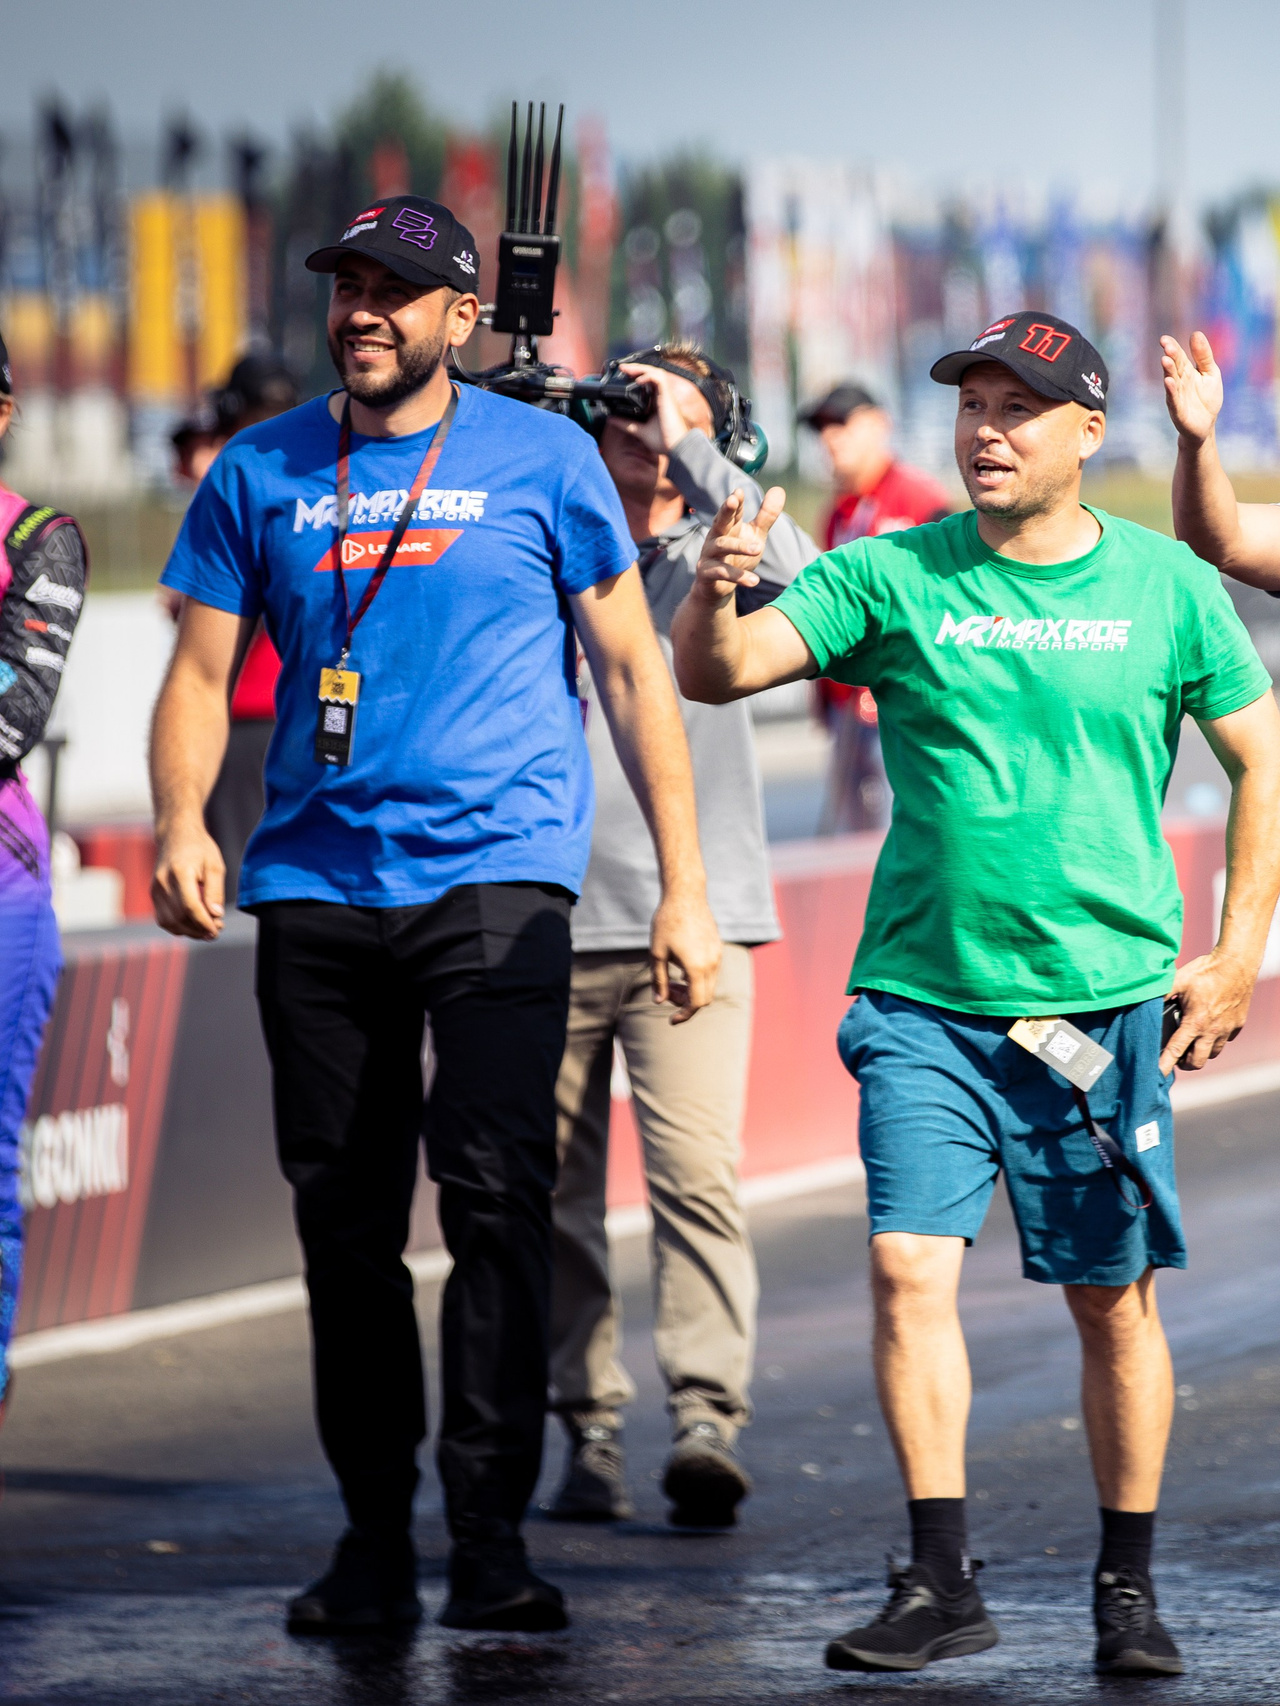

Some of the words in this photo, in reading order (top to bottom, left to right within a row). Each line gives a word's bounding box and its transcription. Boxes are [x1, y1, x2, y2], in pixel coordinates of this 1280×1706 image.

[1018, 323, 1072, 363] 11
[352, 510, 482, 525] MOTOSPORT
[996, 639, 1128, 652] MOTORSPORT
